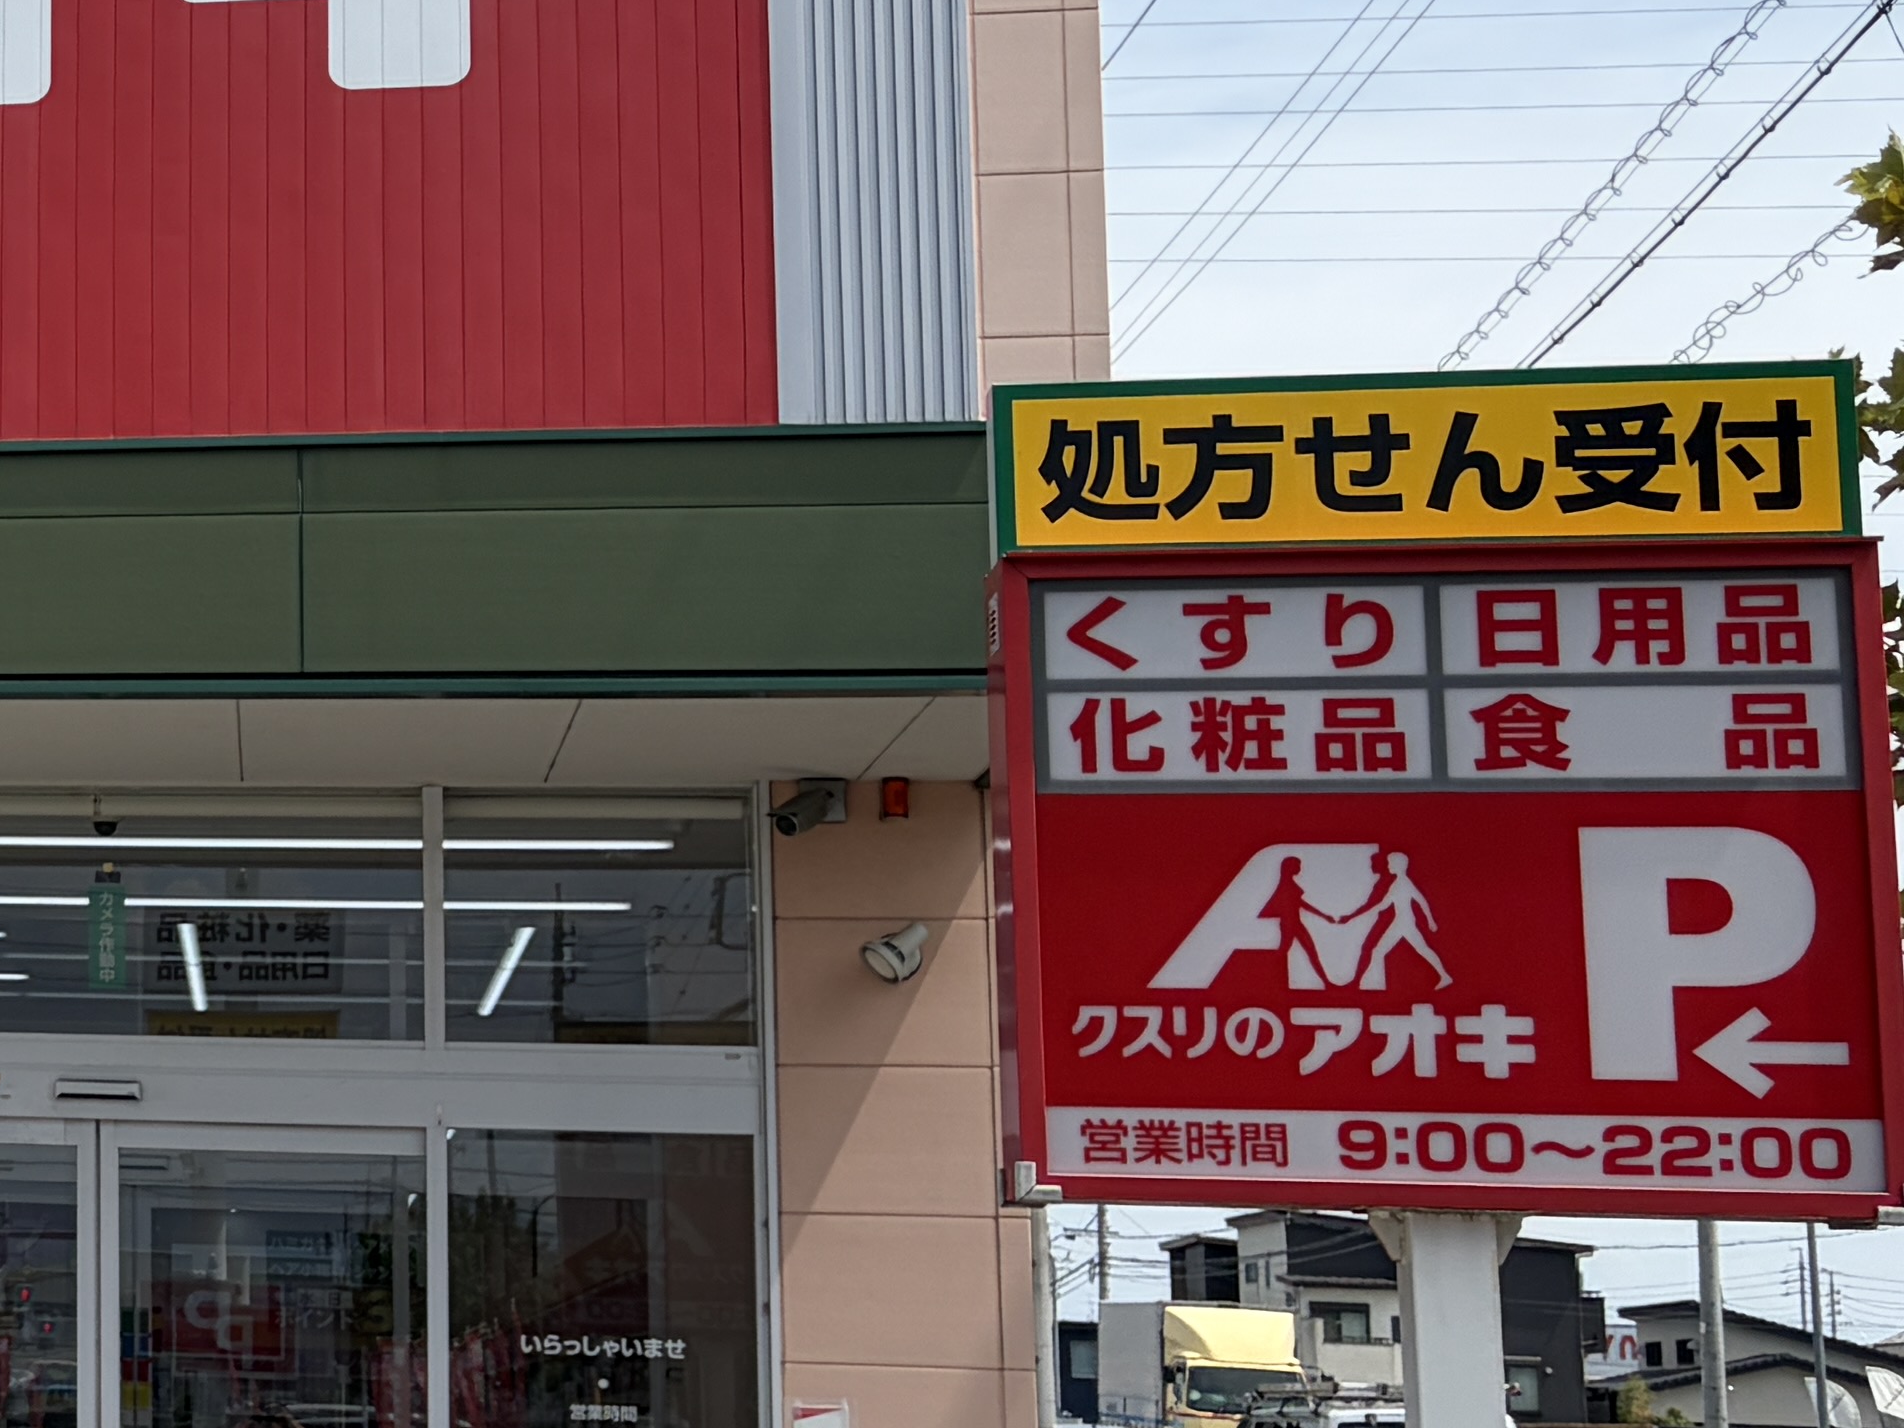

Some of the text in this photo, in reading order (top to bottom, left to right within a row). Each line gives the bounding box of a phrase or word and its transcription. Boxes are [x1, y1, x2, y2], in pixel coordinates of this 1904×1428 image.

[1038, 399, 1811, 523] 処方せん受付
[1066, 594, 1391, 670] くすり
[1475, 583, 1812, 666] 日用品
[1070, 696, 1406, 774] 化粧品
[99, 892, 115, 982] カメラ作動中
[1578, 826, 1816, 1081] P
[1072, 1004, 1535, 1079] クスリのアオキ
[1080, 1121, 1288, 1165] 営業時間
[520, 1334, 687, 1360] いらっしゃいませ
[569, 1403, 638, 1423] 営業時間
